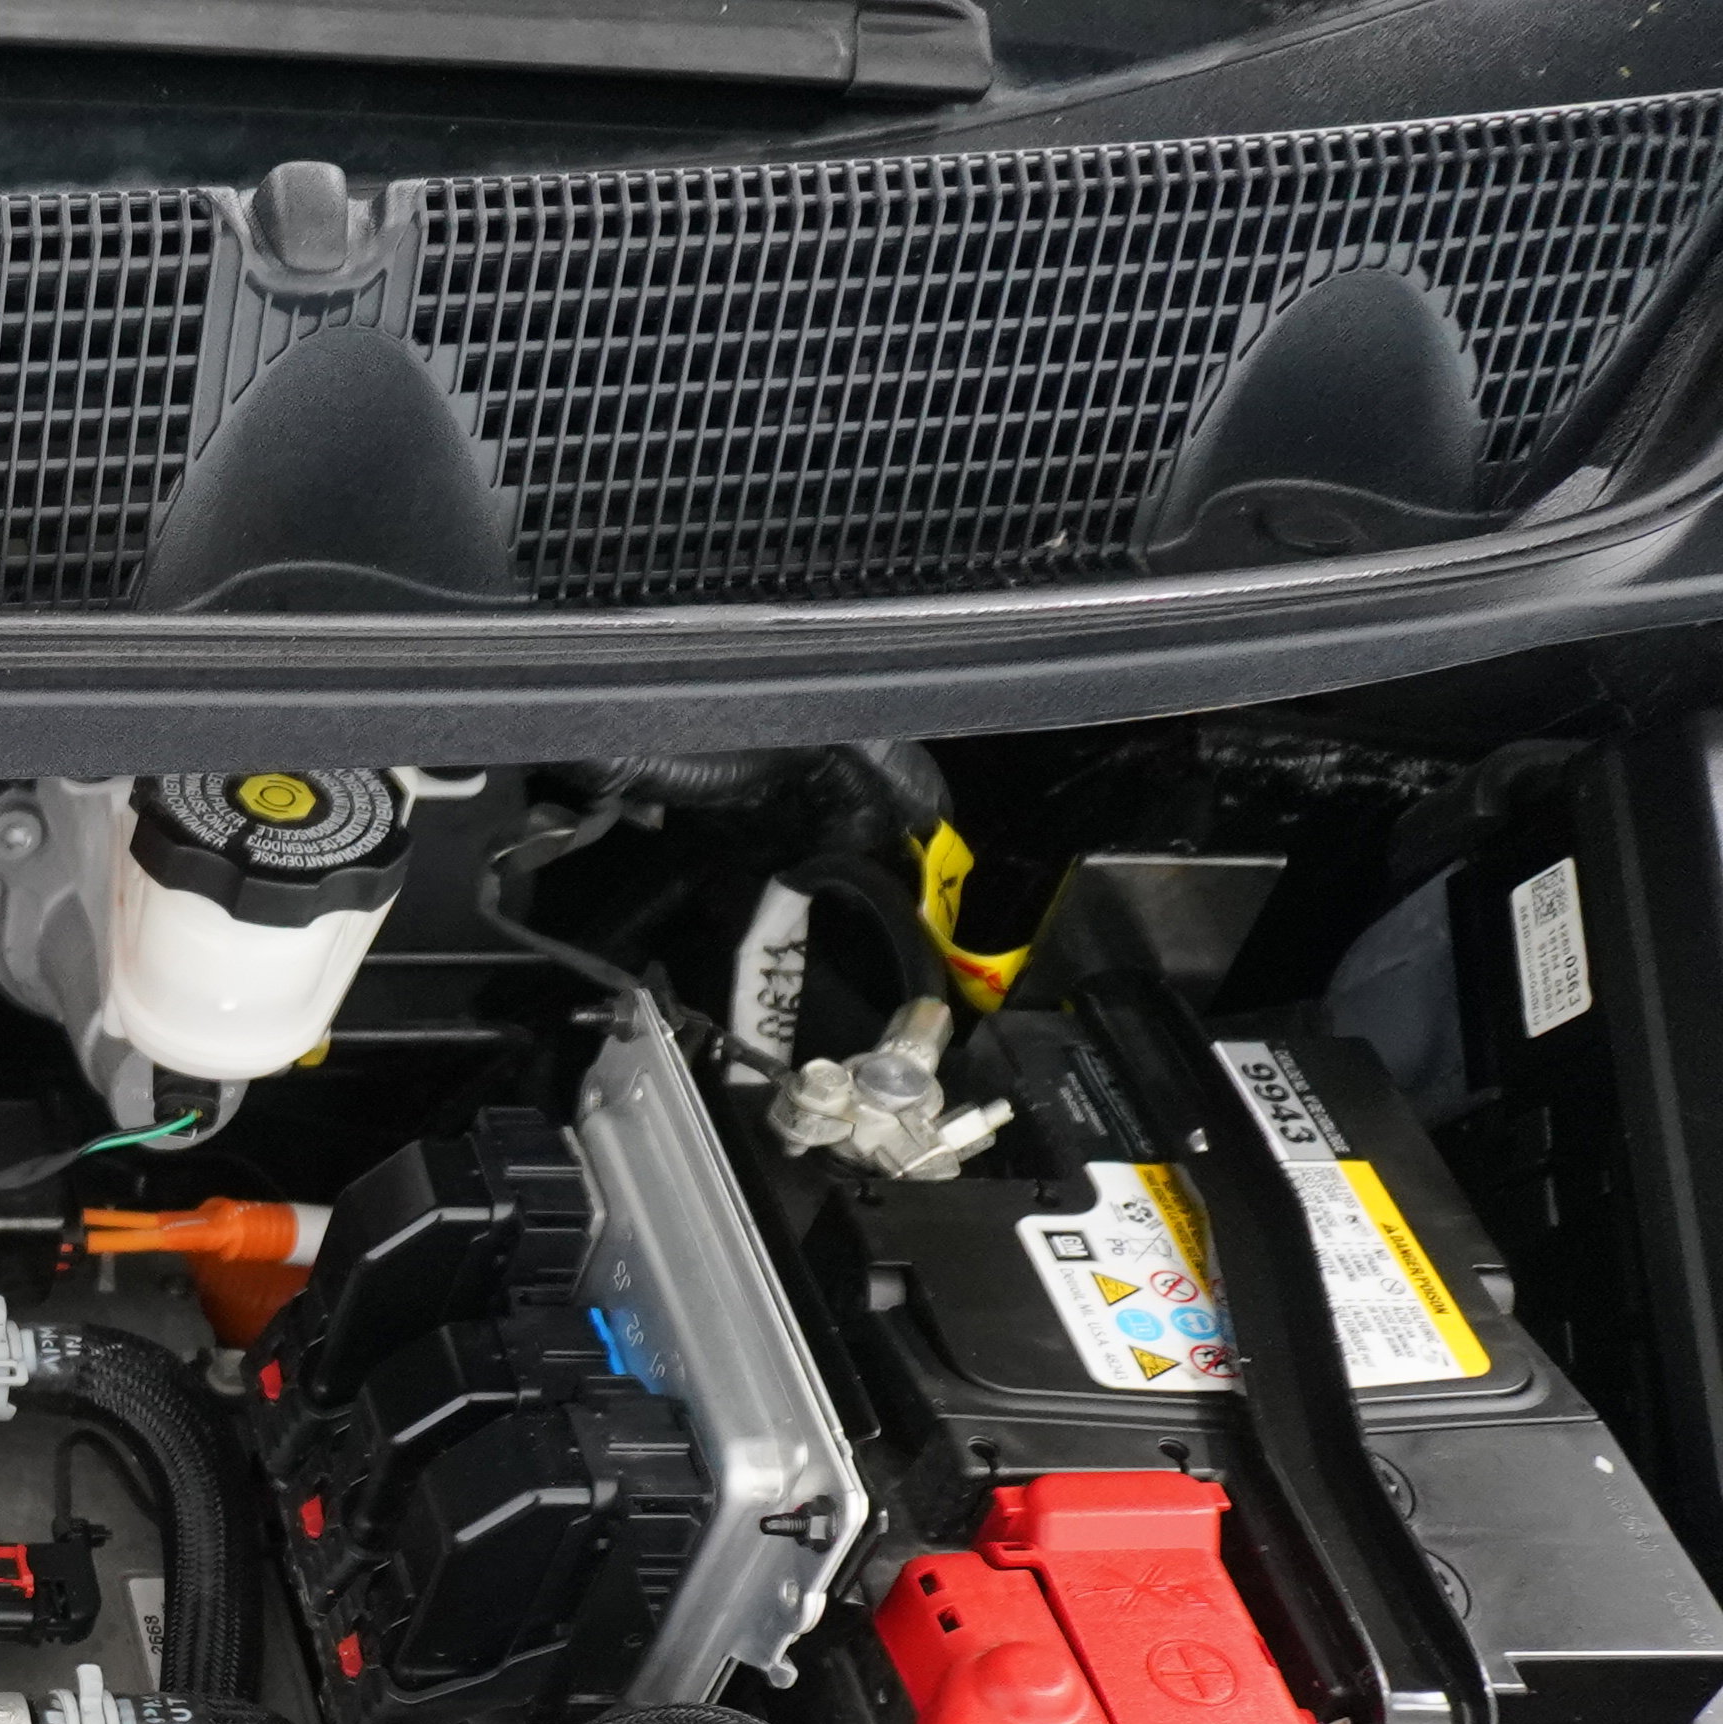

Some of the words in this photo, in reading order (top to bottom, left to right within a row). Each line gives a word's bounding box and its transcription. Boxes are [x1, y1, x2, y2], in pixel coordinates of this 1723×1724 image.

[167, 797, 228, 849] CONTAINER.
[203, 814, 238, 836] ONLY
[209, 797, 247, 827] FILLER
[247, 835, 281, 853] DOT3
[1241, 1063, 1318, 1144] 9943
[1106, 1237, 1126, 1257] Pb
